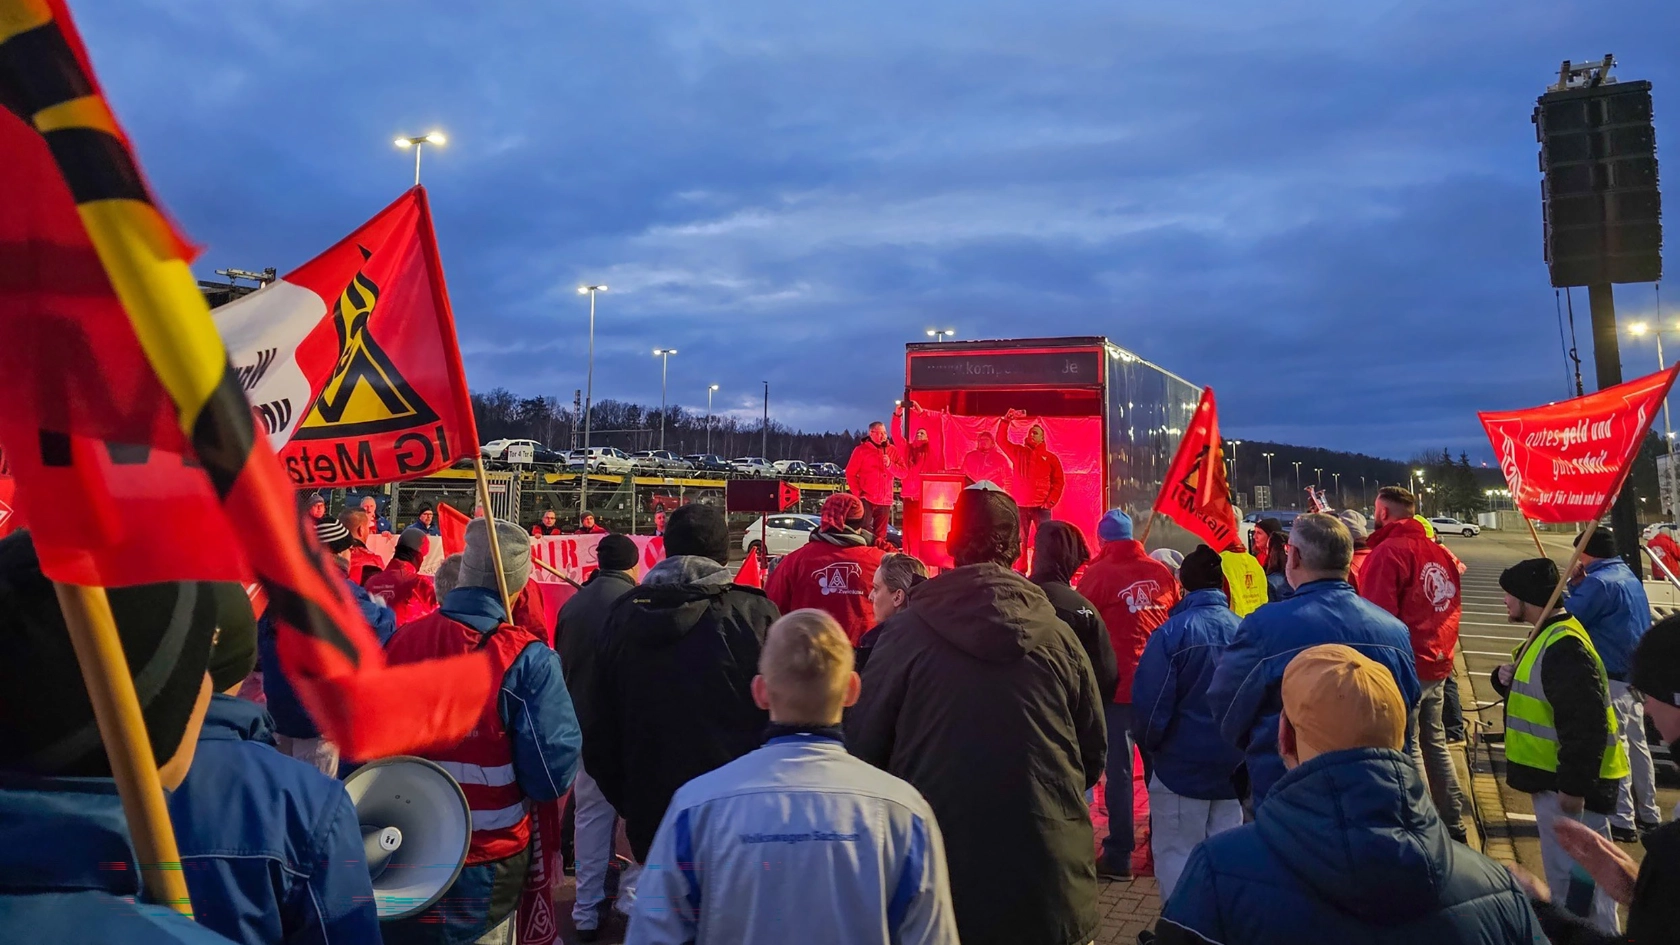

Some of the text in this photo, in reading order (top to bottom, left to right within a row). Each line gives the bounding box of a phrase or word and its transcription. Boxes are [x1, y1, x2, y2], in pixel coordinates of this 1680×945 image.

[1560, 418, 1589, 451] geld
[1591, 413, 1616, 441] und
[1551, 490, 1567, 506] für
[1567, 491, 1584, 506] land
